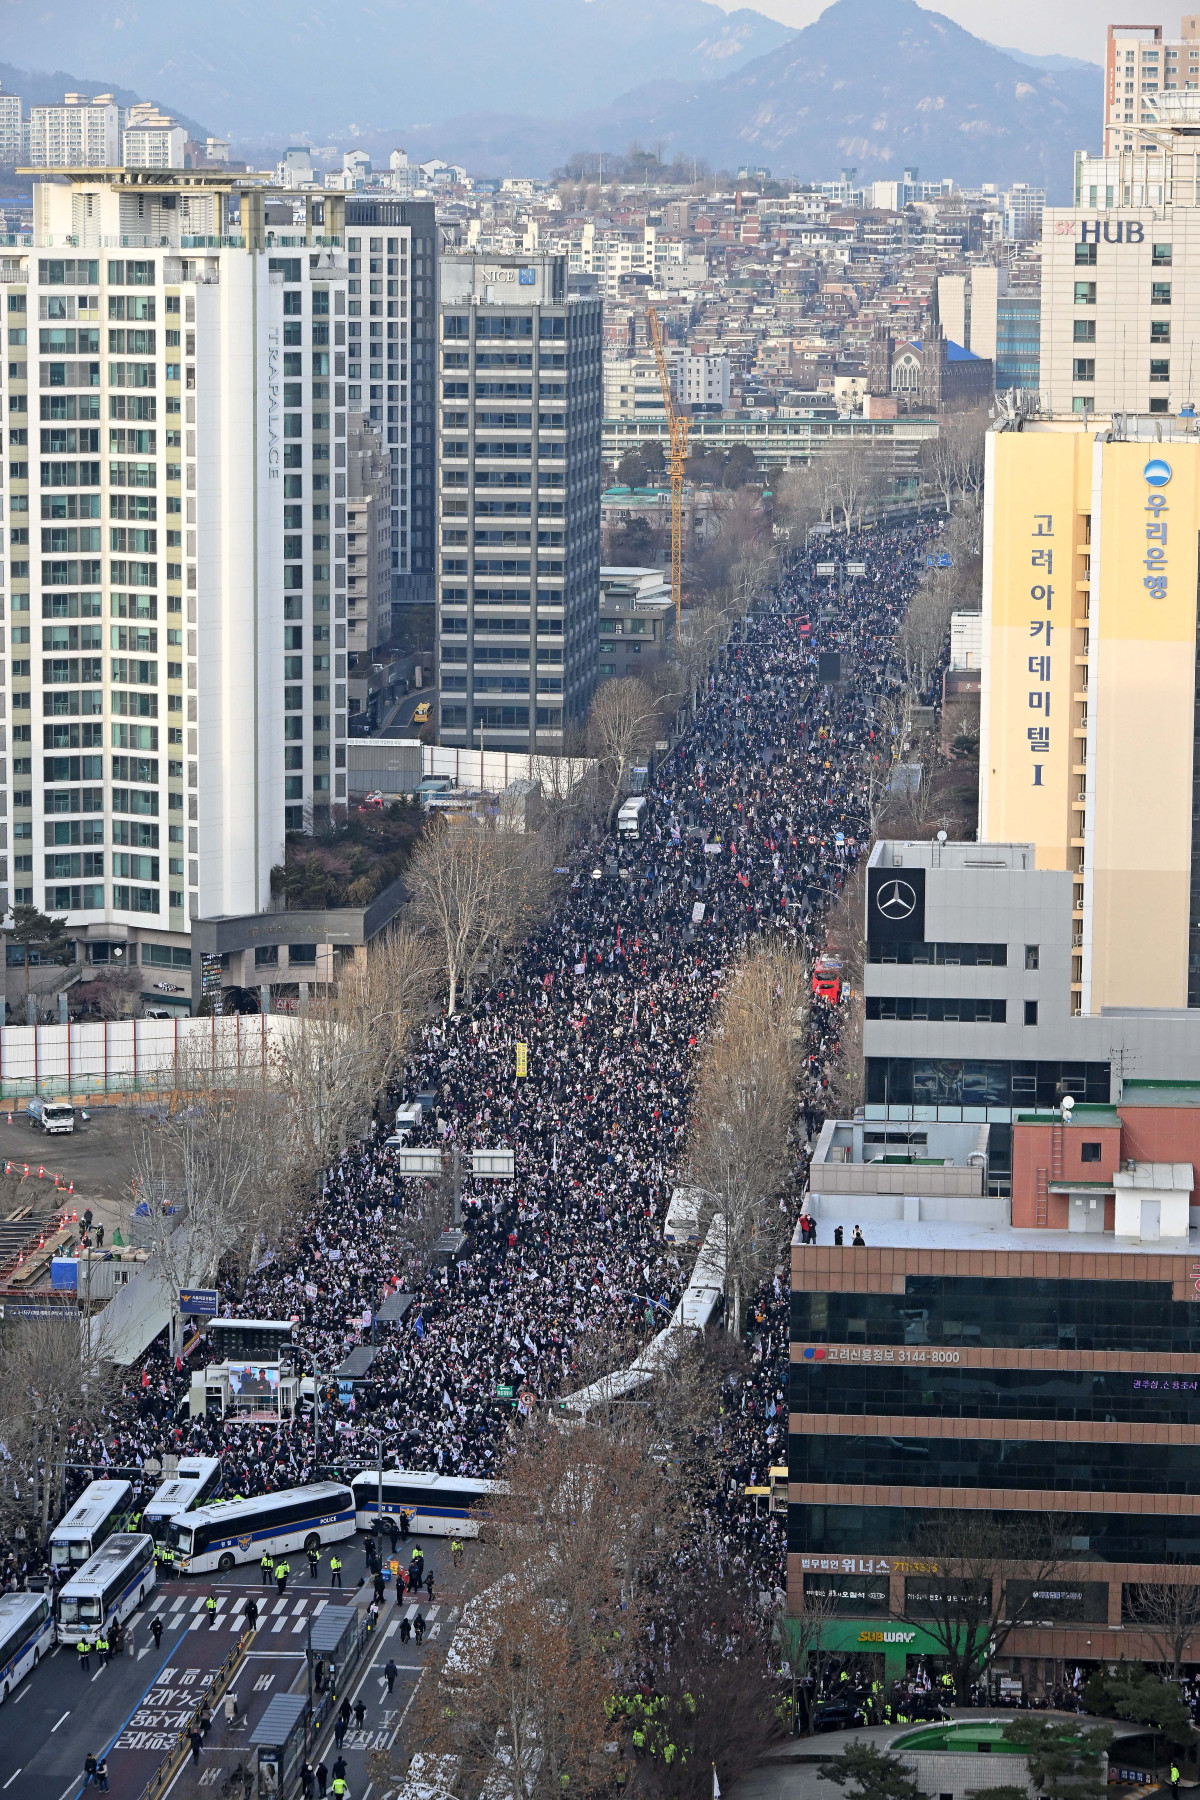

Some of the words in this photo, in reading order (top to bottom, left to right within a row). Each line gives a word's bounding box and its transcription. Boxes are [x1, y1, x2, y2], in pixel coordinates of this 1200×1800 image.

[1055, 220, 1076, 236] SK
[1081, 220, 1145, 244] HUB
[481, 270, 515, 282] NICE
[268, 327, 280, 479] TRAPALACE
[1143, 493, 1170, 600] 우리은행
[1027, 514, 1055, 753] 고려아카데미텔
[827, 1348, 895, 1361] 고려신용정보
[898, 1350, 960, 1363] 3144-8000
[320, 1515, 337, 1524] POLICE
[801, 1558, 839, 1570] 법무법인
[841, 1558, 890, 1574] 위너스
[858, 1631, 916, 1643] SUBWAY
